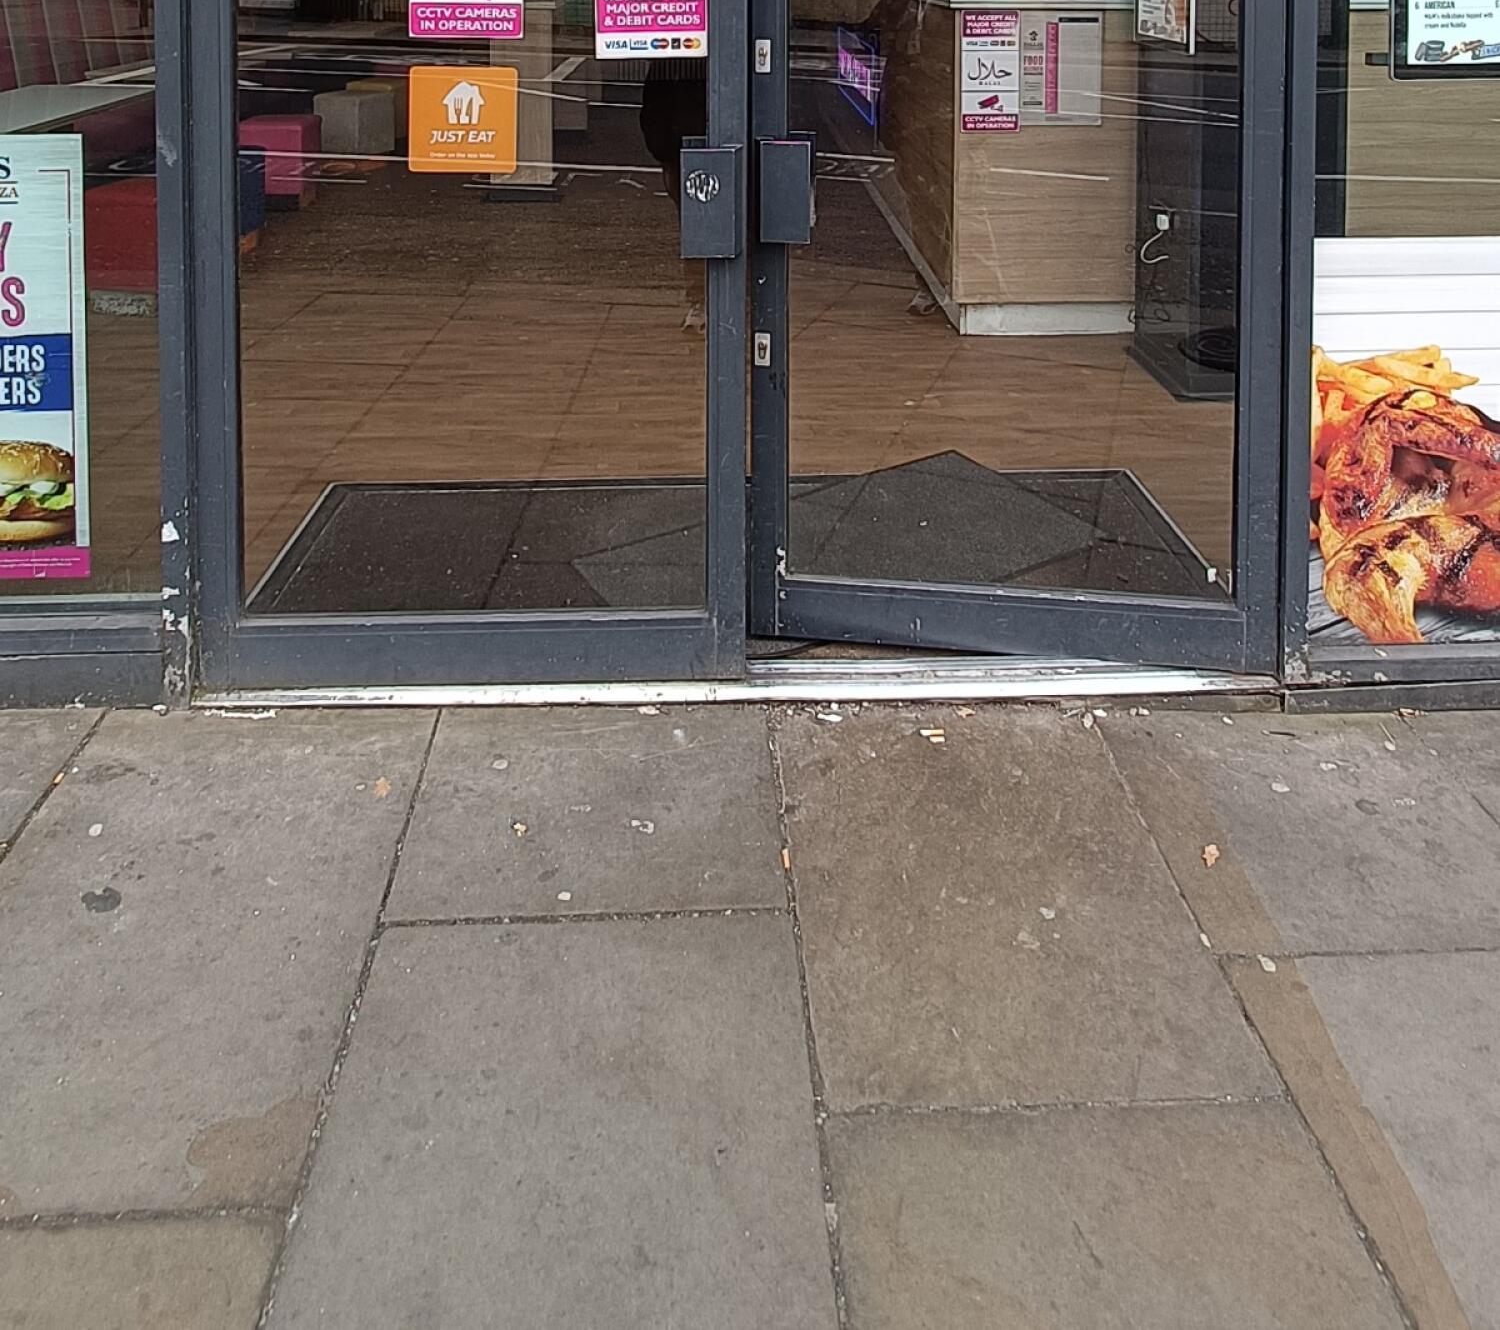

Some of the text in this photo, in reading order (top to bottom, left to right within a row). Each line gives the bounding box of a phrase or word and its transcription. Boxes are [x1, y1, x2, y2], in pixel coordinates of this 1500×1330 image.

[416, 7, 517, 18] CCTV CAMERAS
[606, 1, 698, 15] MAJOR CREDIT
[420, 19, 514, 31] IN OPERATION
[603, 13, 701, 26] & DEBIT CARDS
[605, 40, 628, 49] VISA
[429, 130, 496, 144] JUST EAT
